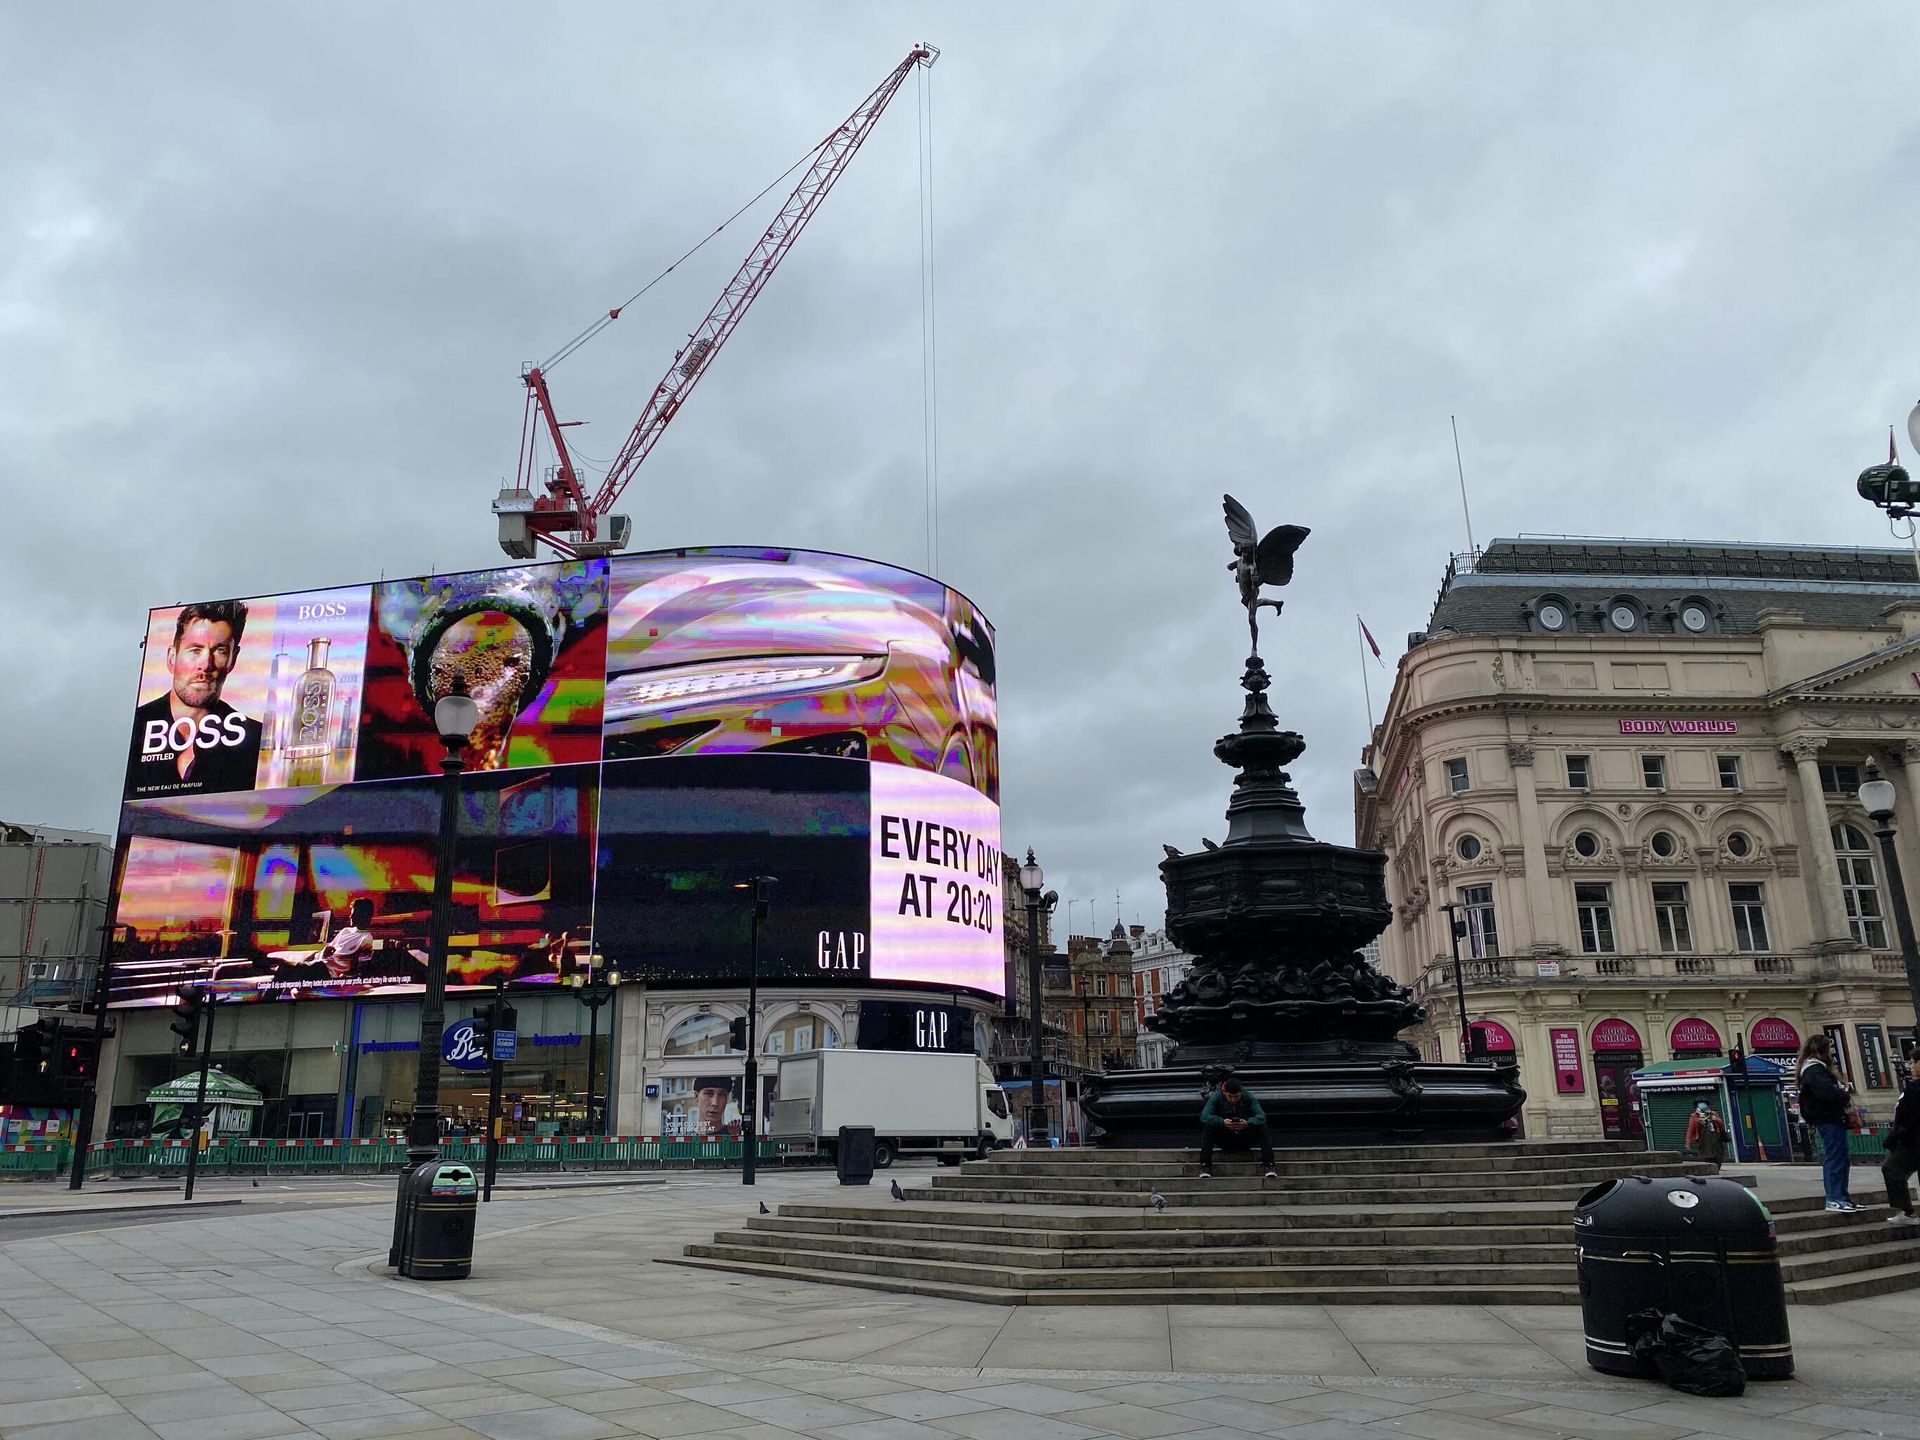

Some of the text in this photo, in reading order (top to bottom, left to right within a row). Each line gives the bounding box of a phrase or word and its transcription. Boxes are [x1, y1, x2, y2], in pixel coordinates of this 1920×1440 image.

[298, 602, 347, 620] BOSS
[142, 712, 247, 754] BOSS
[1620, 720, 1738, 734] BODY WORLDS
[141, 752, 174, 762] BOTTLED
[881, 815, 999, 887] EVERY DAY
[898, 872, 992, 934] AT 20:20
[818, 930, 865, 970] GAP
[916, 1010, 948, 1049] GAP
[1602, 1026, 1627, 1034] BODY
[1682, 1026, 1707, 1034] BODY
[1755, 1032, 1794, 1040] WORLDS
[1761, 1025, 1786, 1033] BODY
[533, 1033, 582, 1047] beauty
[1596, 1034, 1636, 1042] WORLDS
[1676, 1034, 1715, 1042] WORLDS
[362, 1040, 420, 1055] pharmac
[1862, 1034, 1877, 1086] TOBACCO
